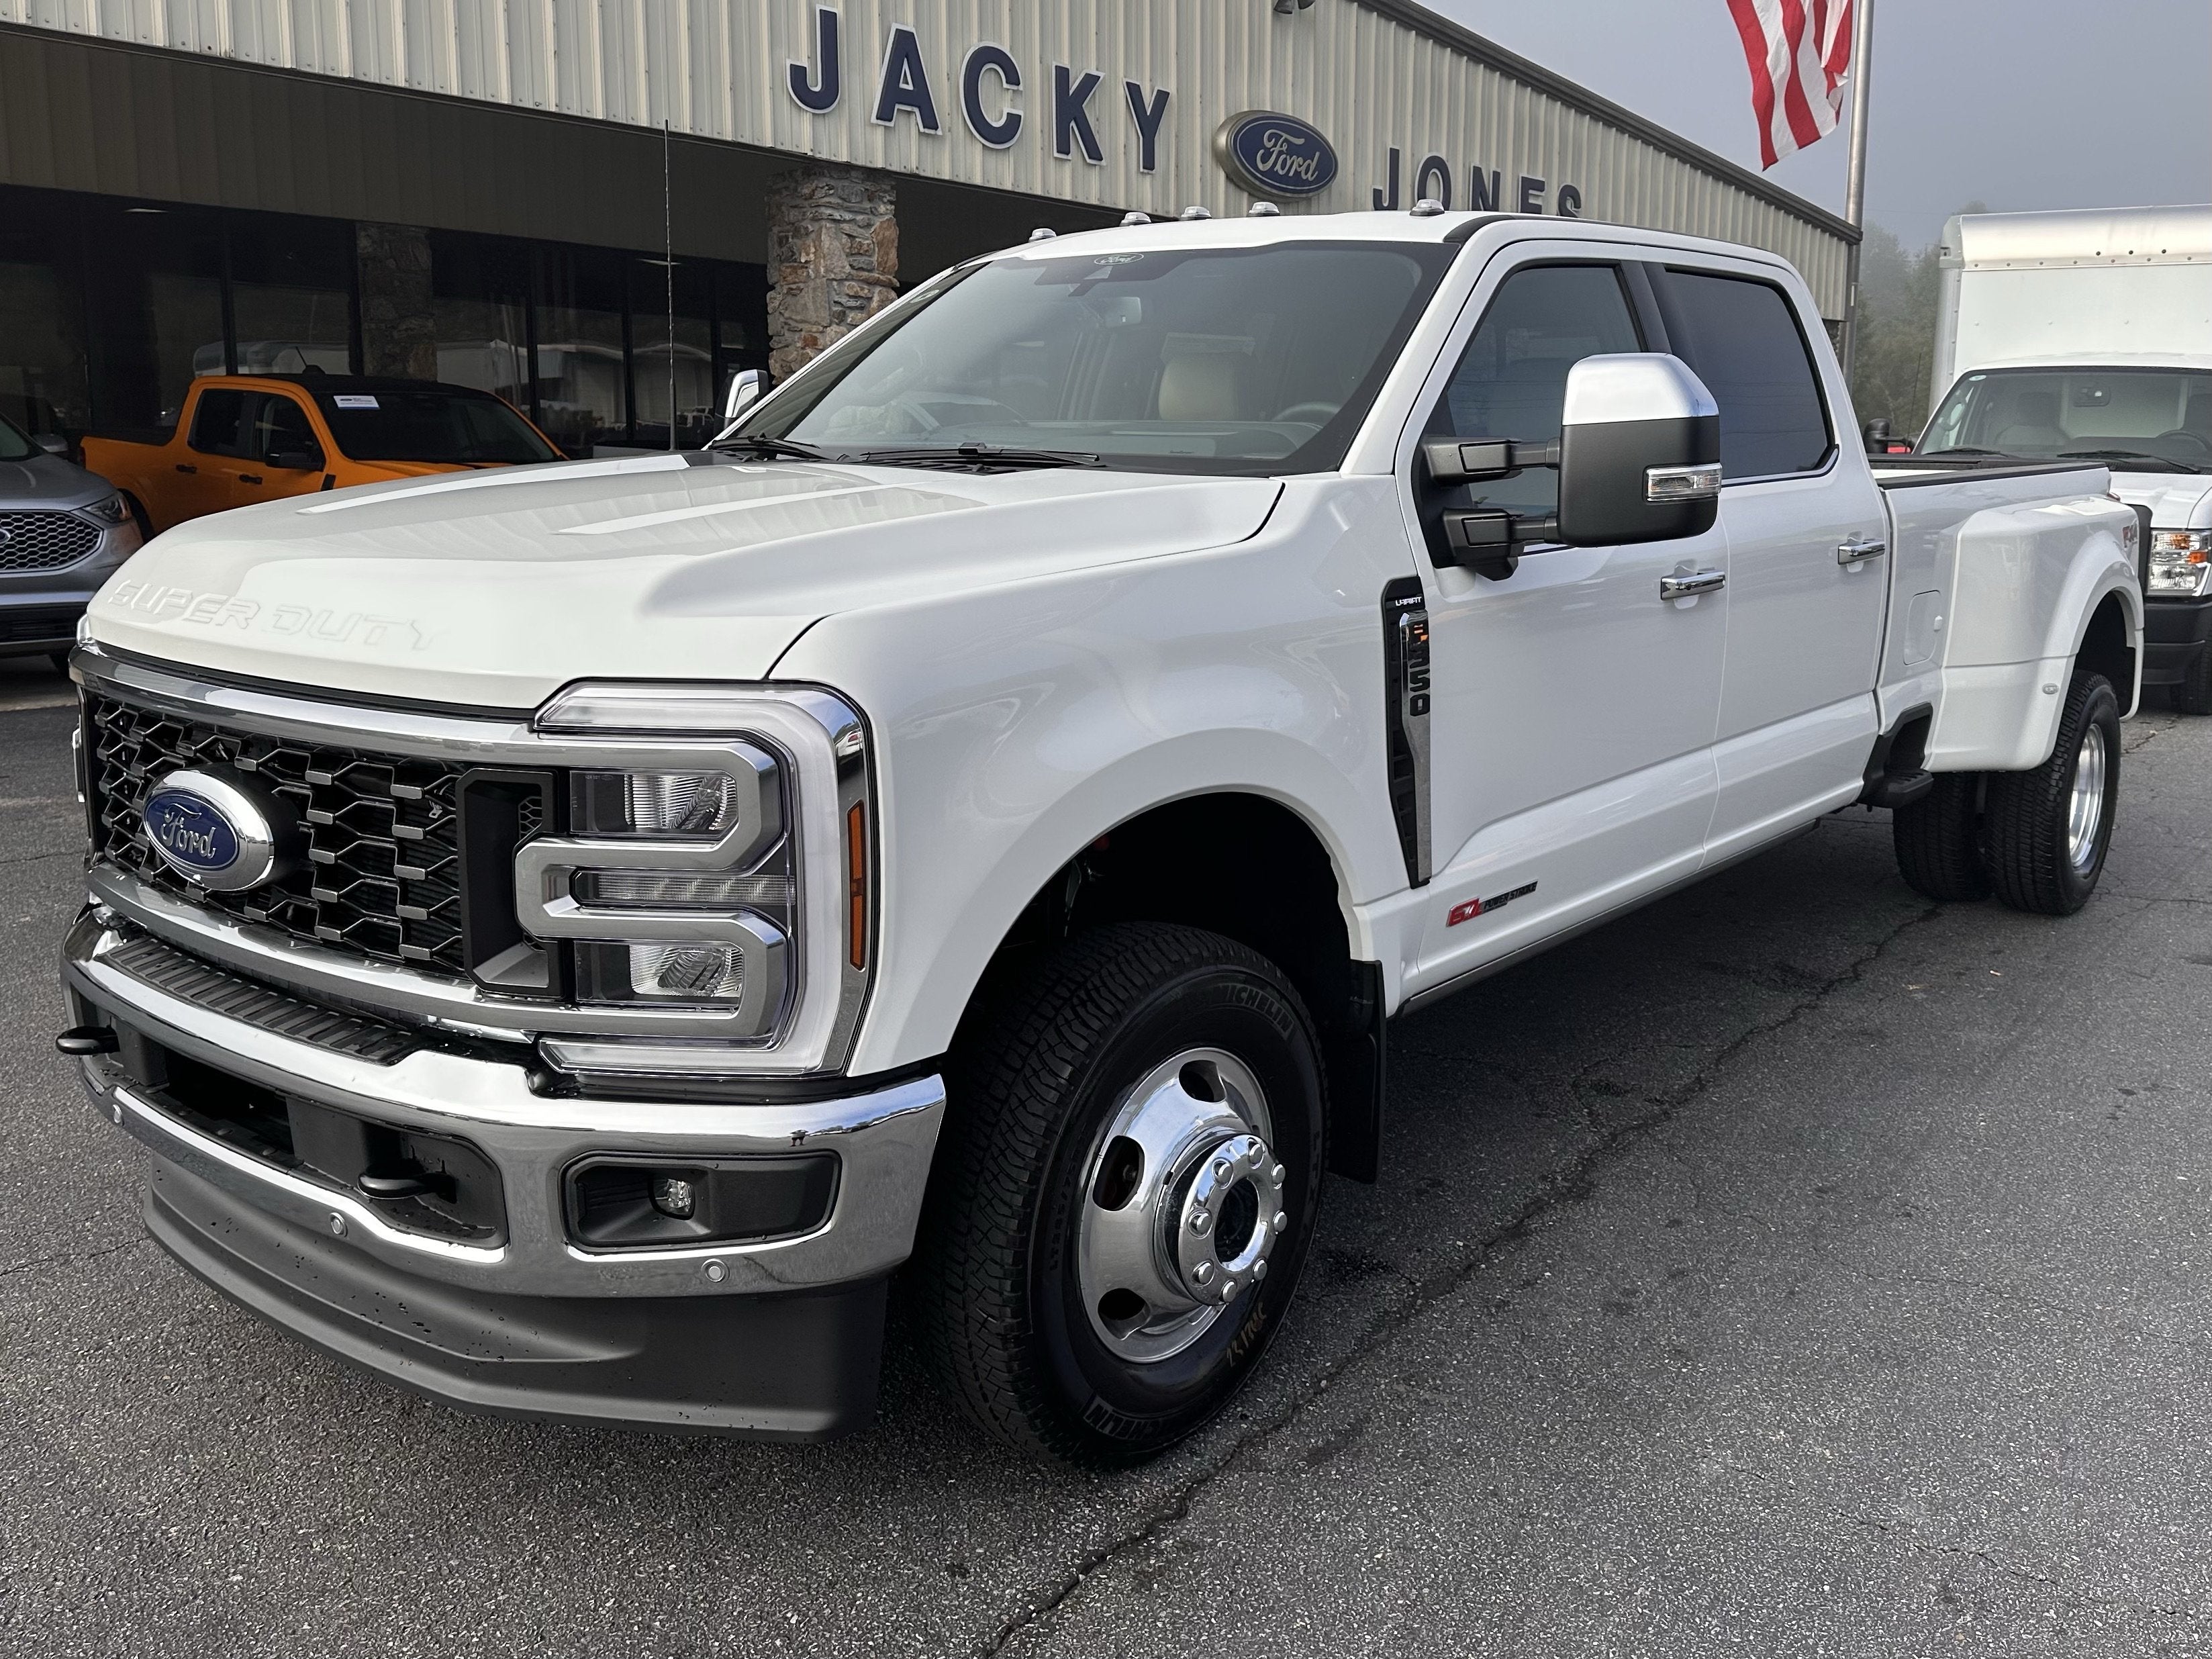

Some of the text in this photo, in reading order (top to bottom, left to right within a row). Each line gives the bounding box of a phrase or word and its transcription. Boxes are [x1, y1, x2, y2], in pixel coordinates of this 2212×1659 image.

[786, 5, 1170, 174] JACKY
[1256, 129, 1320, 181] Ford
[1372, 146, 1582, 218] JONES
[108, 579, 444, 651] SUPER DUTY
[160, 803, 216, 859] Ford
